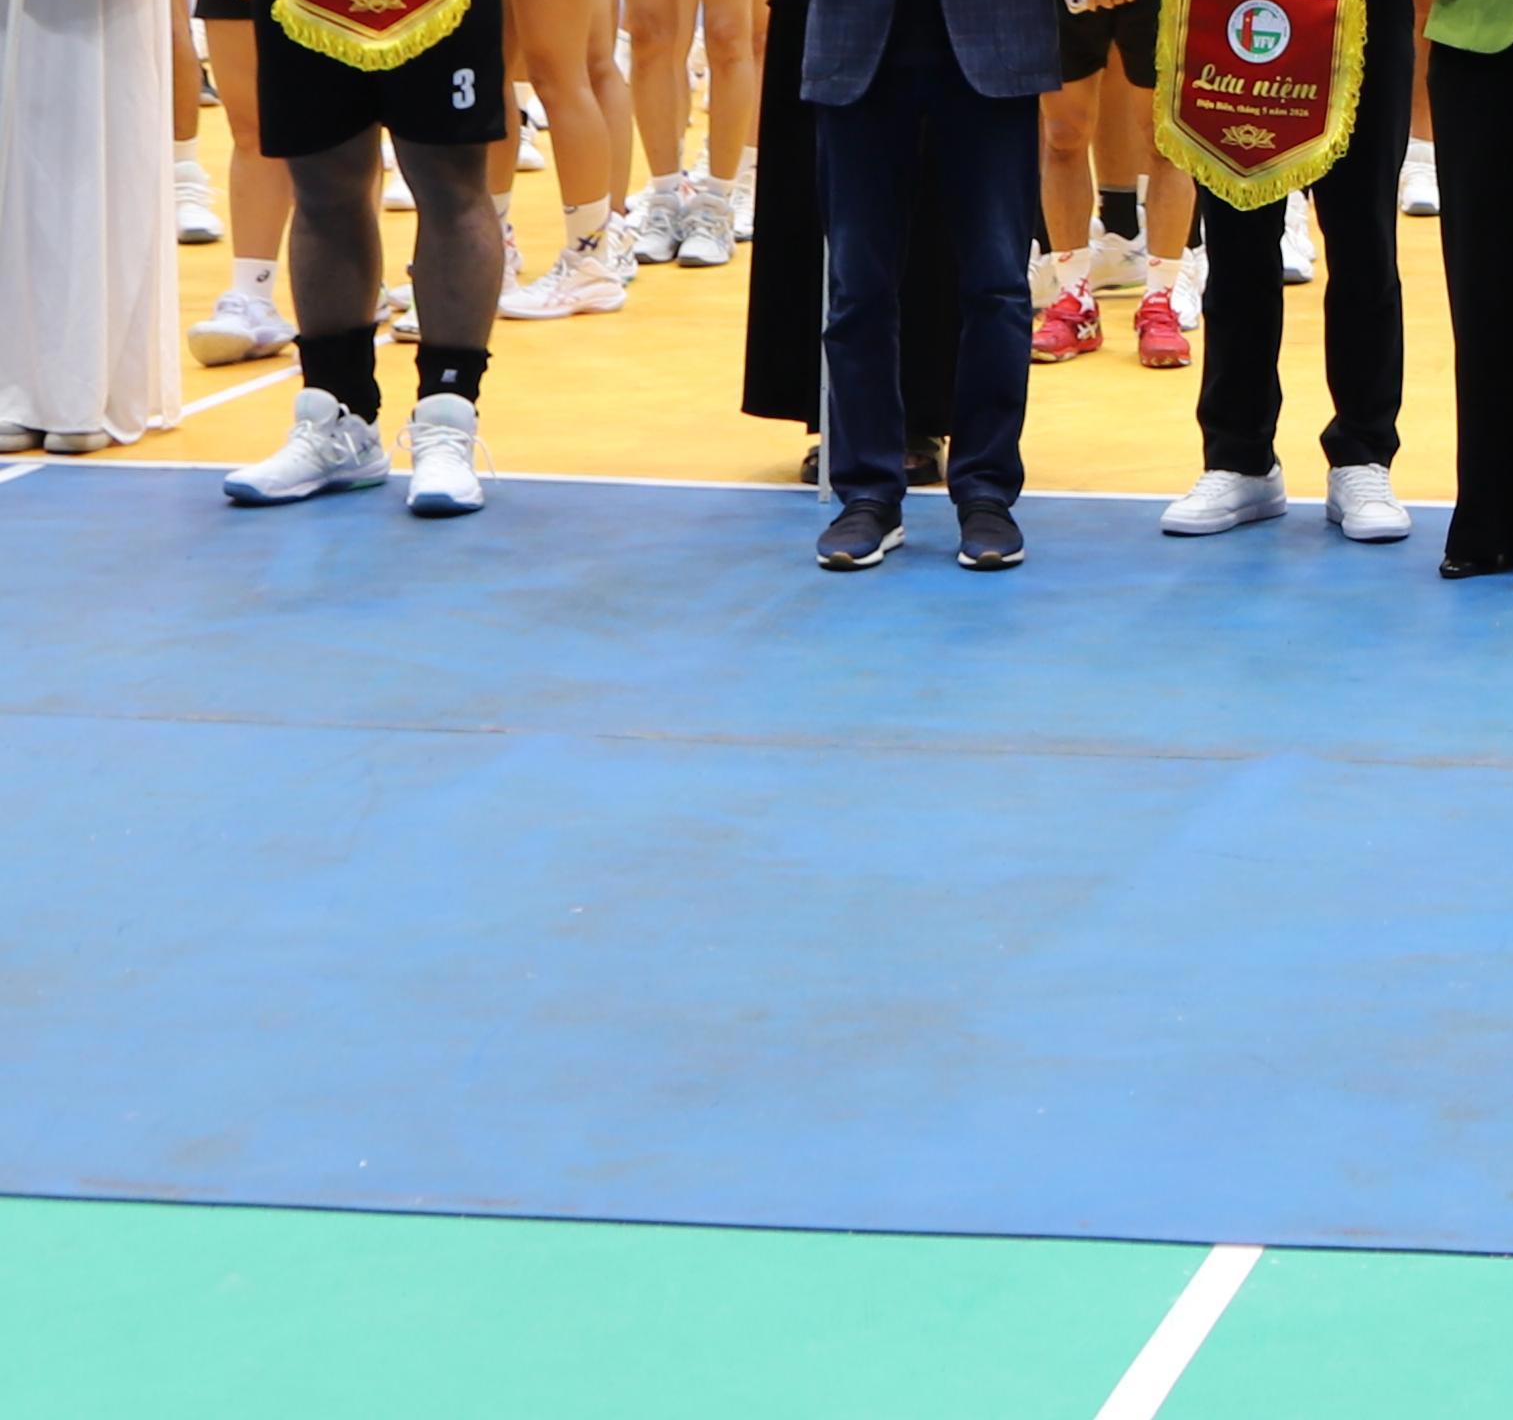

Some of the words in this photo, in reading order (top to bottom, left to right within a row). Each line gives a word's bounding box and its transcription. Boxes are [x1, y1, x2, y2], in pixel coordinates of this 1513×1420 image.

[1254, 36, 1276, 49] VFV
[453, 68, 475, 109] 3
[1192, 64, 1244, 94] Lưu
[1252, 76, 1318, 103] niệm
